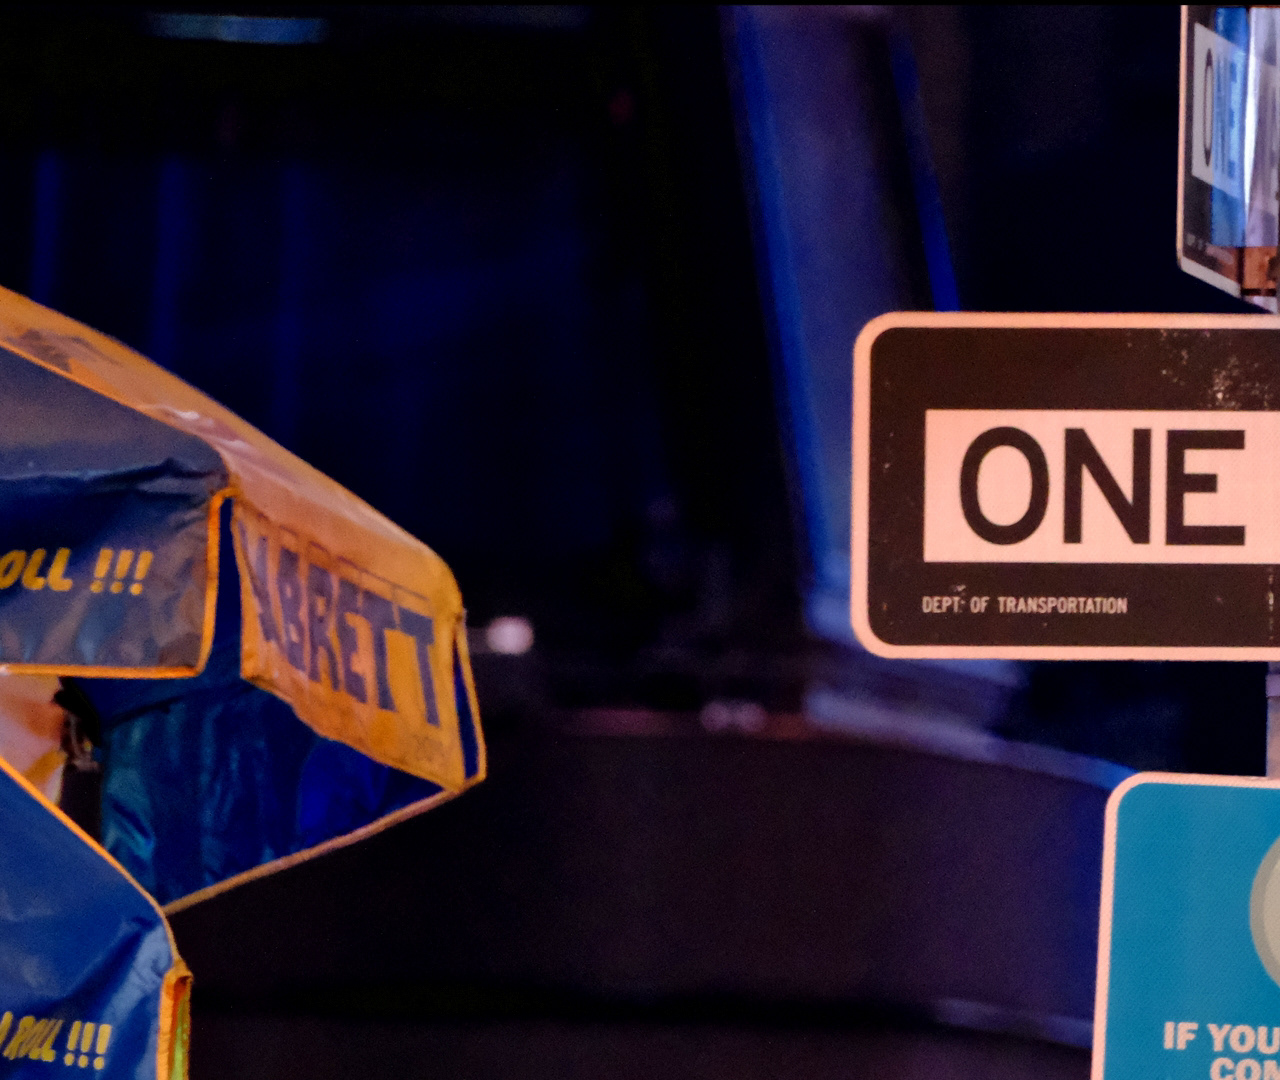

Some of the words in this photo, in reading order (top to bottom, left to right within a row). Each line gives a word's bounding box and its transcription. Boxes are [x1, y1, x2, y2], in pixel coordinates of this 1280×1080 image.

[959, 426, 1246, 546] ONE
[969, 597, 990, 613] OF
[998, 597, 1128, 613] TRANSPORTATION
[1163, 1022, 1198, 1050] IF
